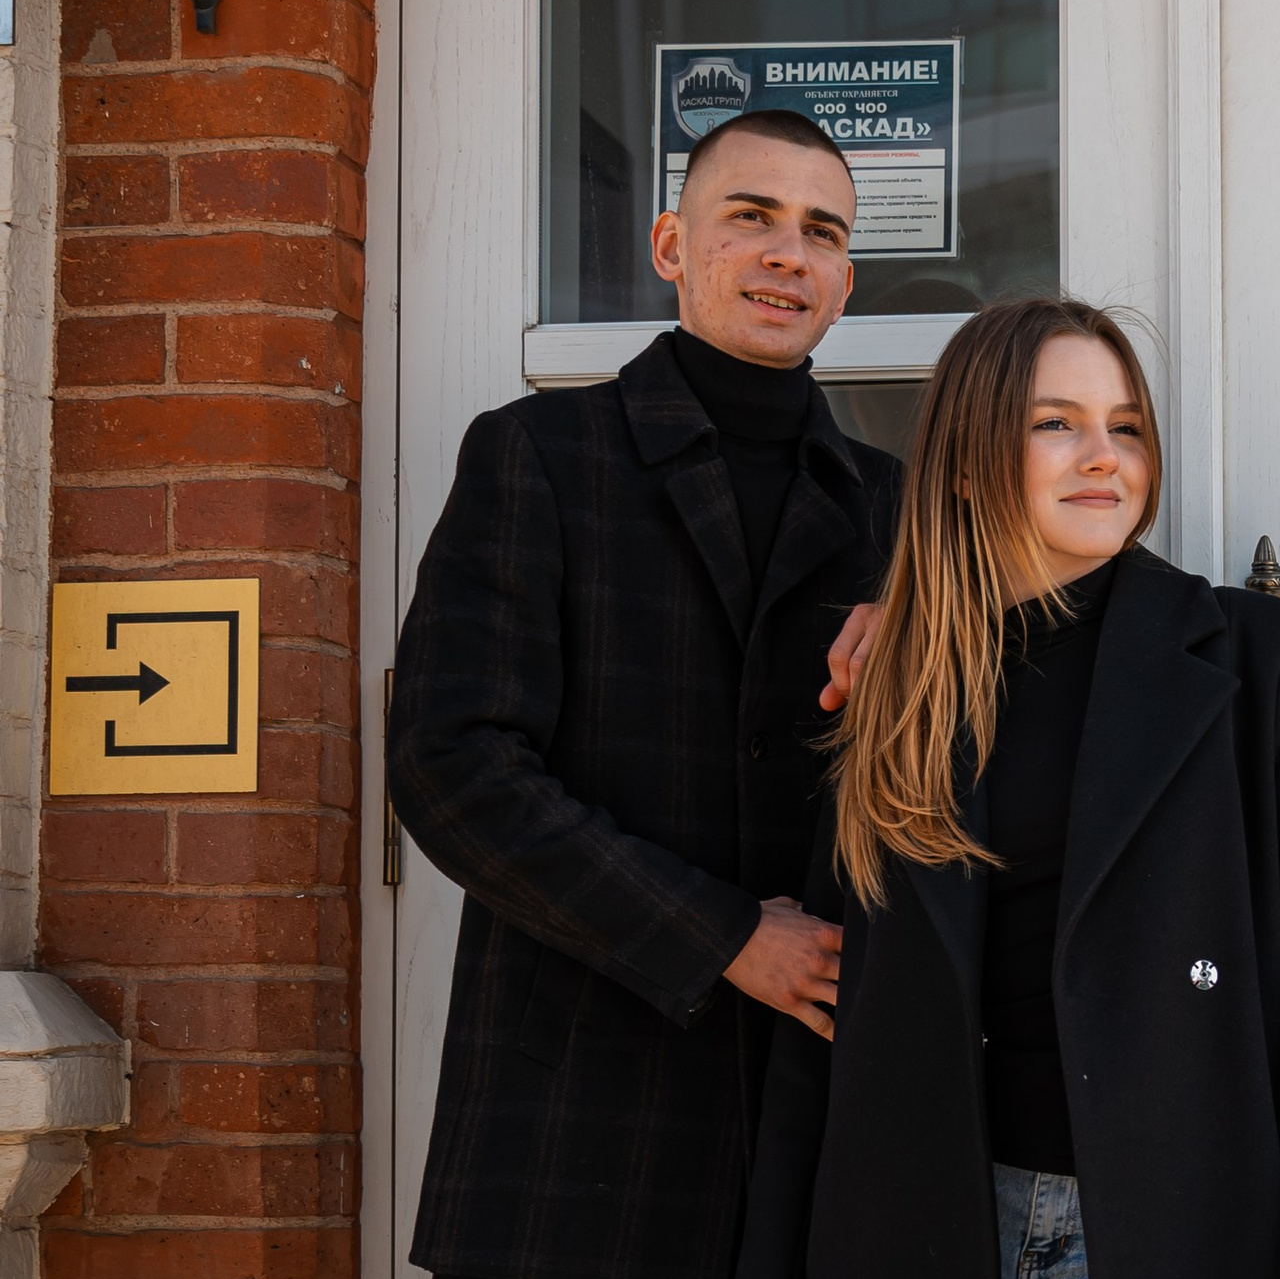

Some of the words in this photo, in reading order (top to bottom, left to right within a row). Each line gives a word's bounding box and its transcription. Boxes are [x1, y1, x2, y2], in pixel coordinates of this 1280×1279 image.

[765, 60, 938, 82] ВНИМАНИЕ!
[804, 90, 840, 99] ОБЪЕКТ
[841, 89, 898, 99] ОХРАНЯЕТСЯ
[680, 96, 714, 108] КАСКАД
[714, 96, 742, 107] ГРУПП
[814, 103, 846, 115] ООО
[813, 118, 931, 139] АСКАД»
